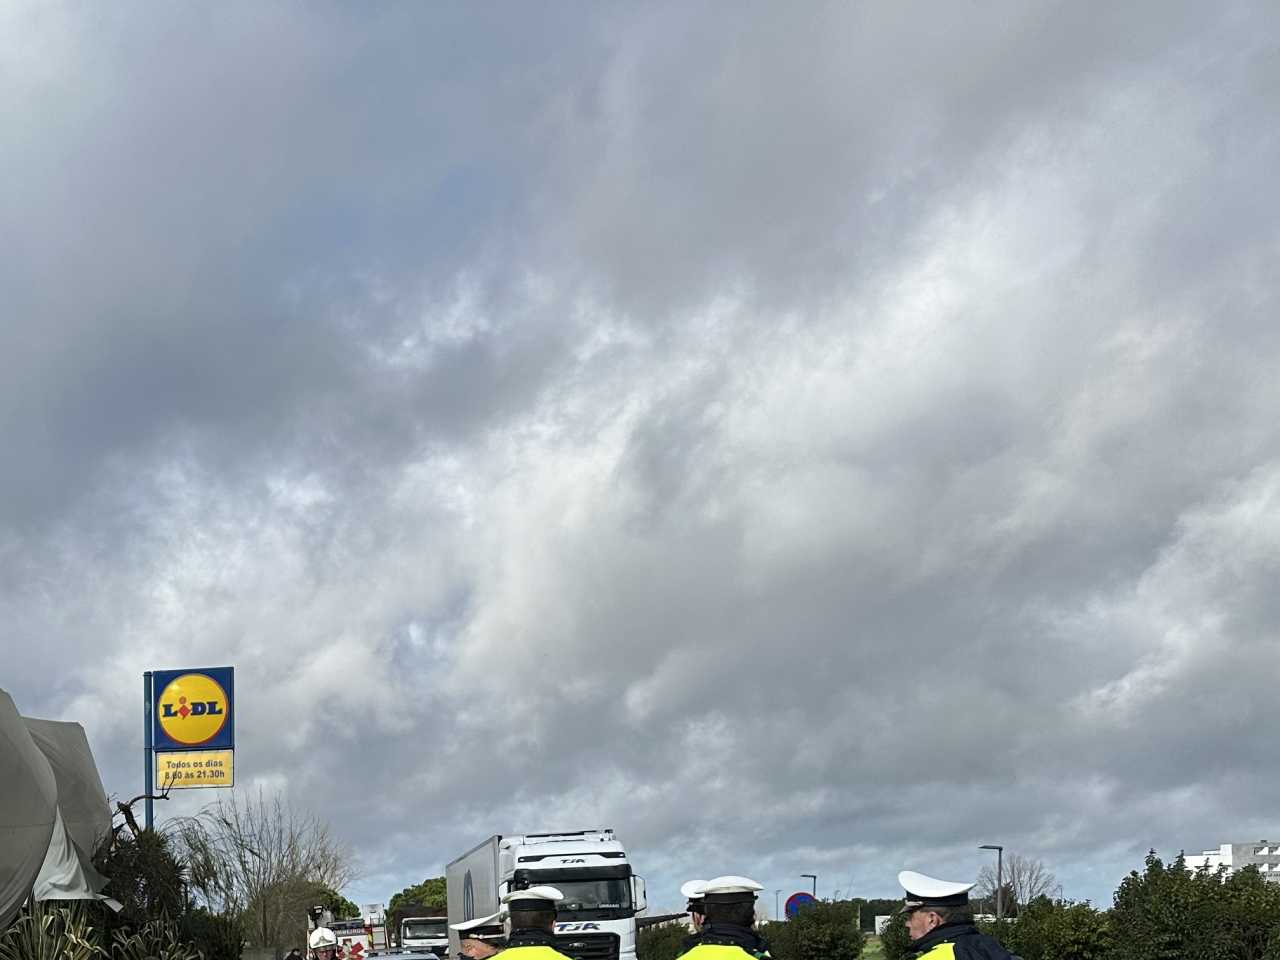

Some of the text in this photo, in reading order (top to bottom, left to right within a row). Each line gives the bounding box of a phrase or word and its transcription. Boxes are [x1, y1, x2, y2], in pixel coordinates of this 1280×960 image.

[167, 761, 191, 769] Todos
[205, 760, 223, 768] dias
[197, 770, 224, 778] 21.30h
[558, 922, 601, 931] TJA
